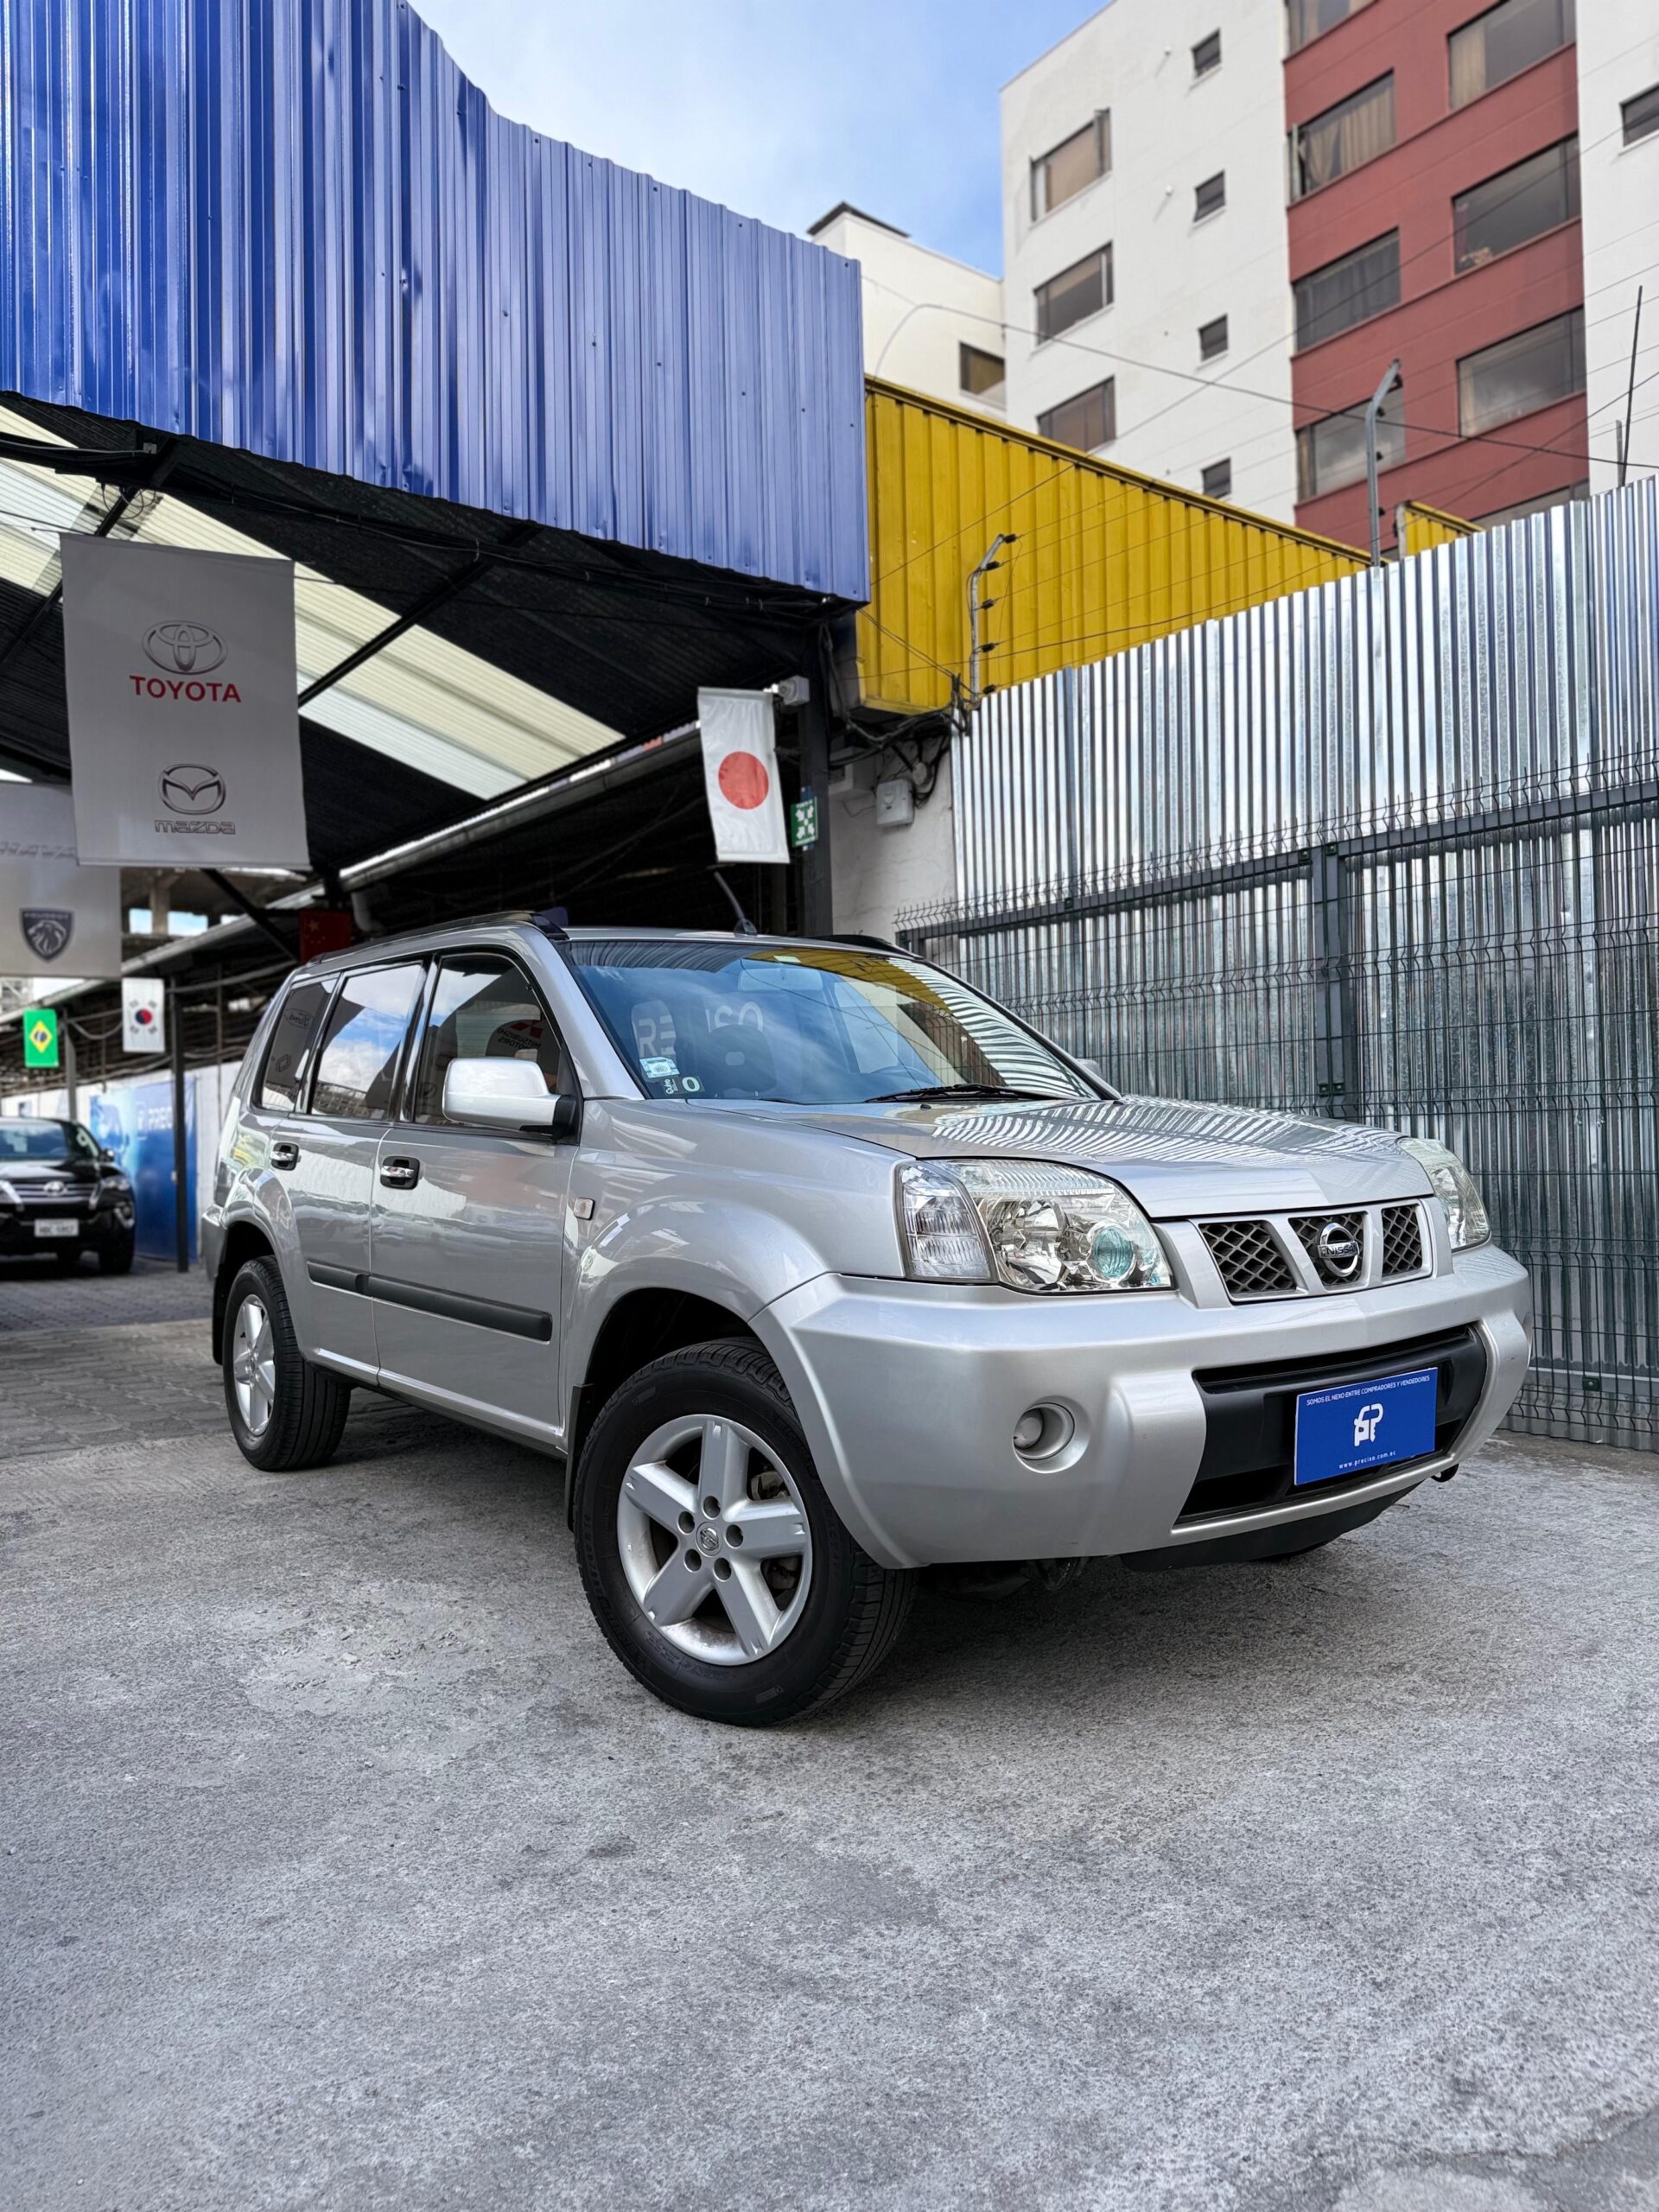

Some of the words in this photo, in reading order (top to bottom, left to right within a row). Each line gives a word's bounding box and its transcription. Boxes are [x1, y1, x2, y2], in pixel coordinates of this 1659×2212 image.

[129, 675, 242, 702] TOYOTA
[1306, 1396, 1325, 1406] SOMOS
[1345, 1389, 1361, 1398] ENTRE
[1361, 1382, 1396, 1395] COMPRADORES
[1400, 1375, 1430, 1386] VENDEDORES
[1338, 1450, 1396, 1469] www.preciso.com.ec
